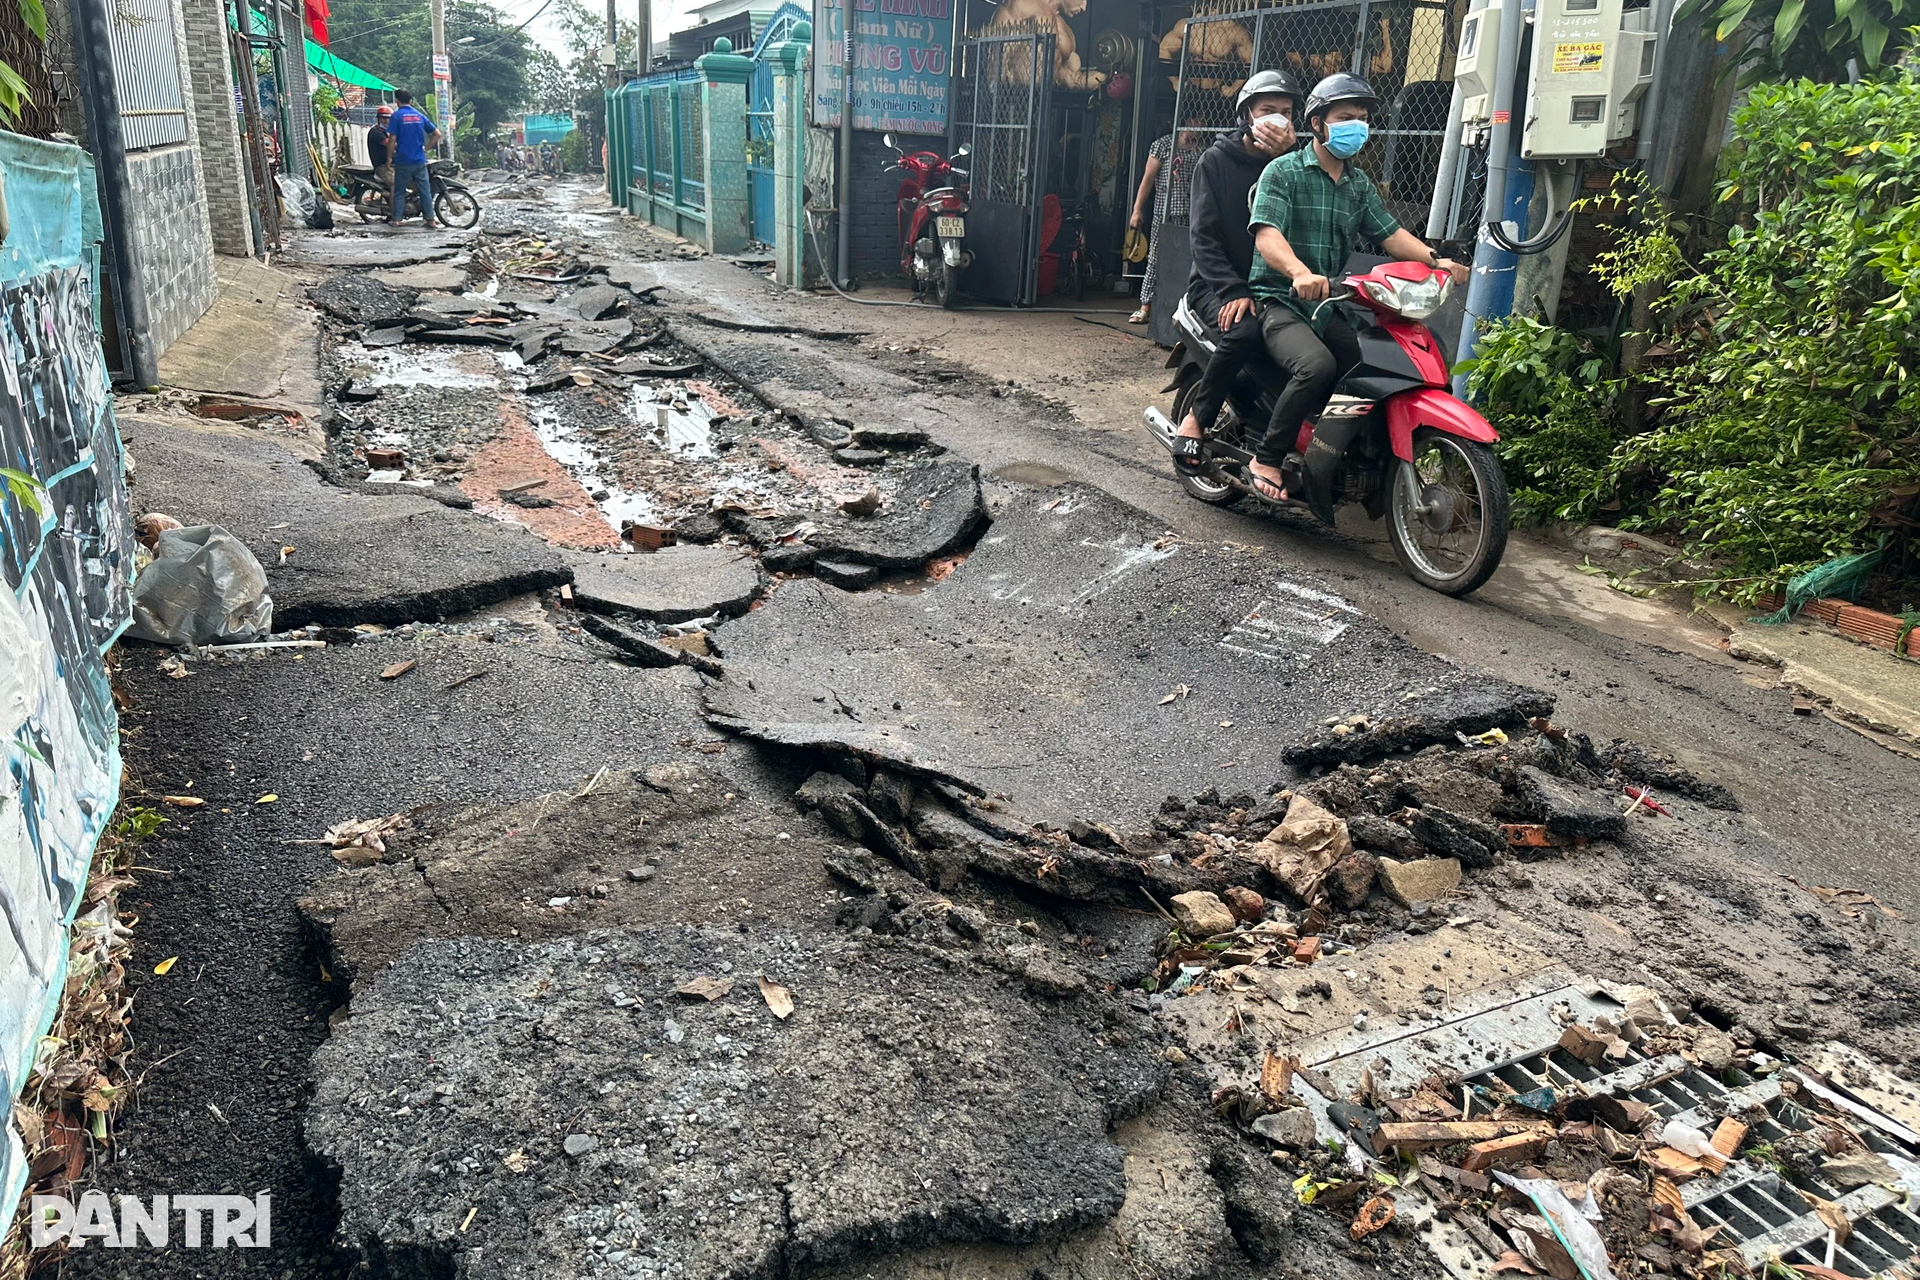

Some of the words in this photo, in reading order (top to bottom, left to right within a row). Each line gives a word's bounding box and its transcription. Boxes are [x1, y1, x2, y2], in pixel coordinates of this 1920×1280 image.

[853, 16, 889, 37] am
[908, 43, 946, 74] VŨ
[872, 77, 896, 94] Viên
[898, 75, 918, 96] Mỗi
[920, 81, 946, 101] Ngày
[907, 101, 922, 112] 15h
[1312, 436, 1337, 455] YAMAHA
